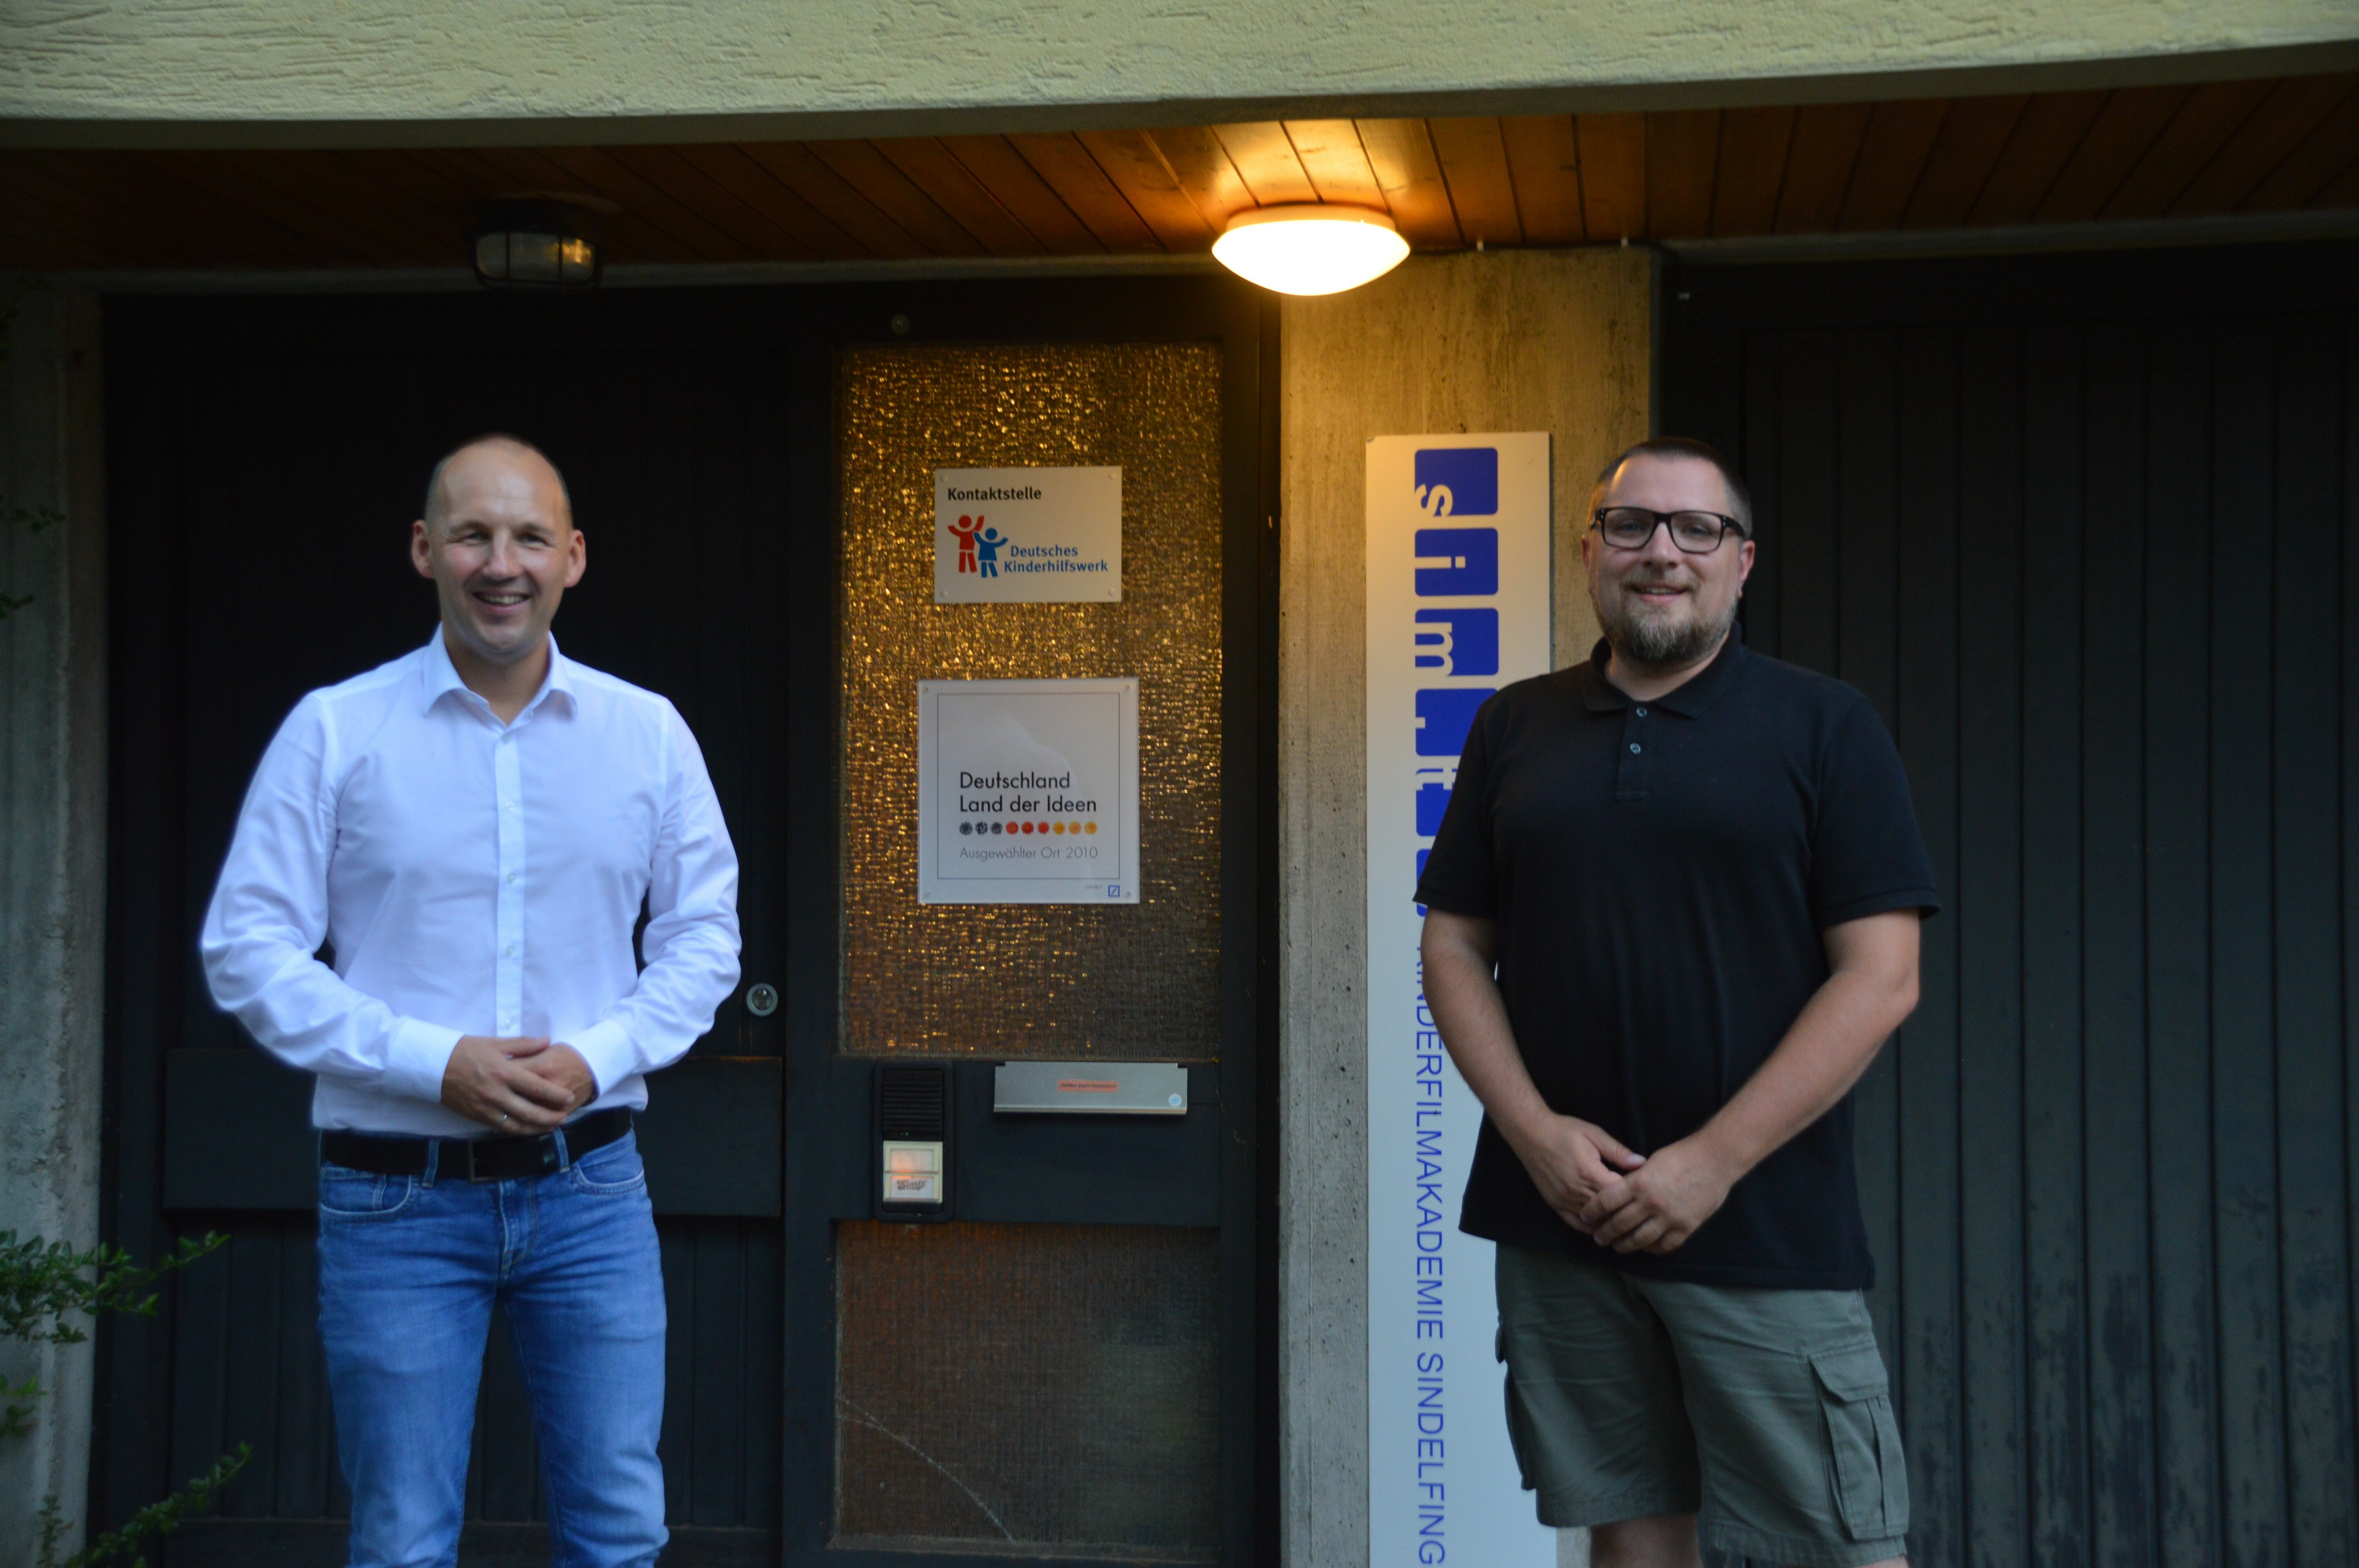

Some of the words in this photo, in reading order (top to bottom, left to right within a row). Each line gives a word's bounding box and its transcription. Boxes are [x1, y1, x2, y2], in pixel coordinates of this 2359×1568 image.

[948, 487, 1042, 501] Kontaktstelle
[1010, 545, 1078, 557] Deutsches
[1004, 560, 1109, 573] Kinderhilfswerk
[960, 771, 1070, 789] Deutschland
[960, 795, 1003, 813] Land
[1010, 795, 1040, 812] der
[1047, 795, 1097, 812] Ideen
[959, 846, 1036, 861] Ausgewählter
[1041, 846, 1060, 859] Ort
[1066, 846, 1098, 859] 2010
